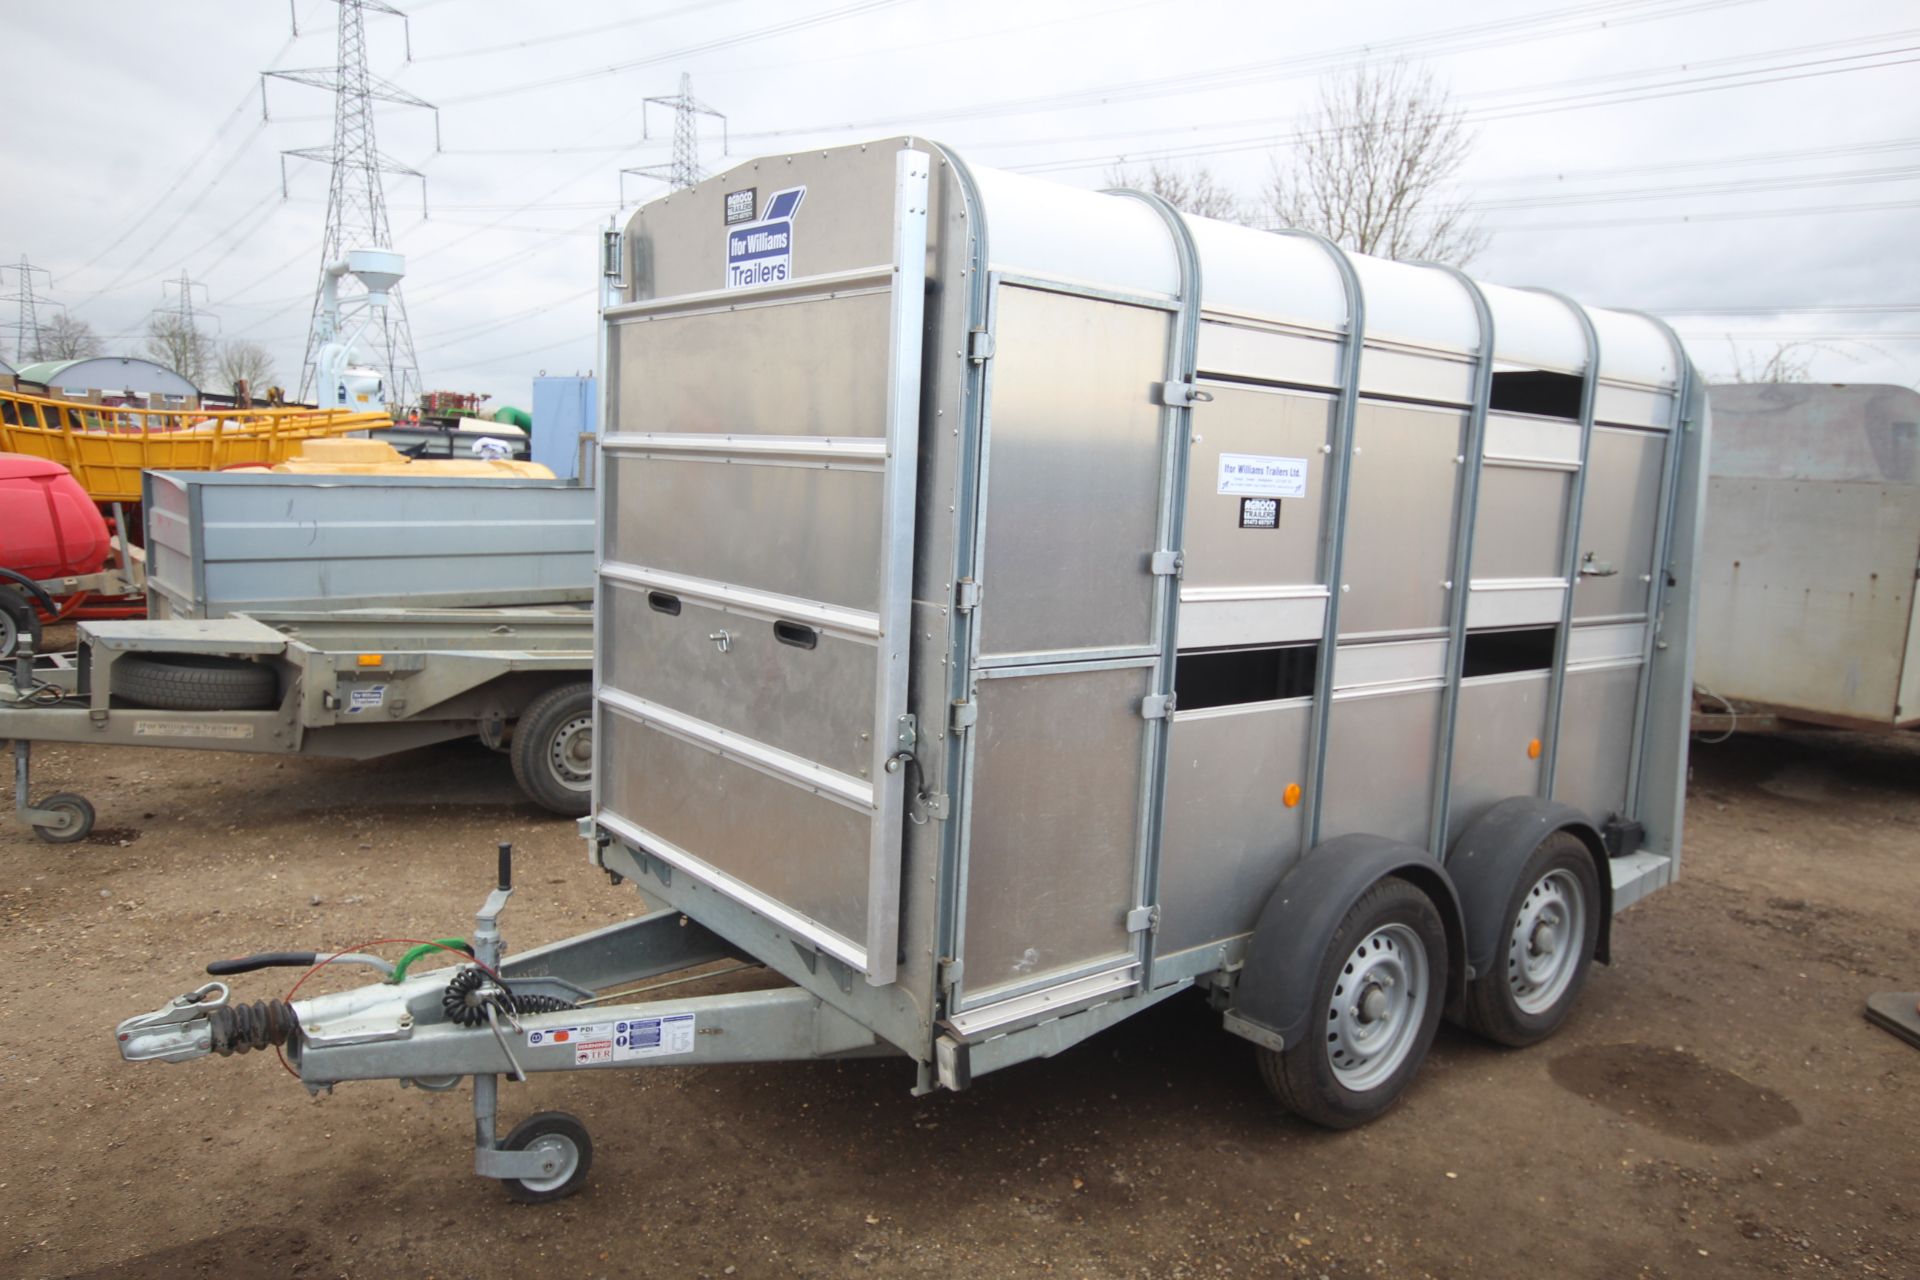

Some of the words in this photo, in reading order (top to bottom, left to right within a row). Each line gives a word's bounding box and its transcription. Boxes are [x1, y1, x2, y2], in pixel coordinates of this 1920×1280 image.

[731, 238, 746, 257] Ifor
[747, 232, 787, 253] Williams
[731, 263, 786, 286] Trailers
[1224, 463, 1236, 473] Ifor
[1238, 464, 1264, 475] Williams
[1266, 466, 1289, 477] Trailers
[1244, 500, 1276, 511] AGROCO
